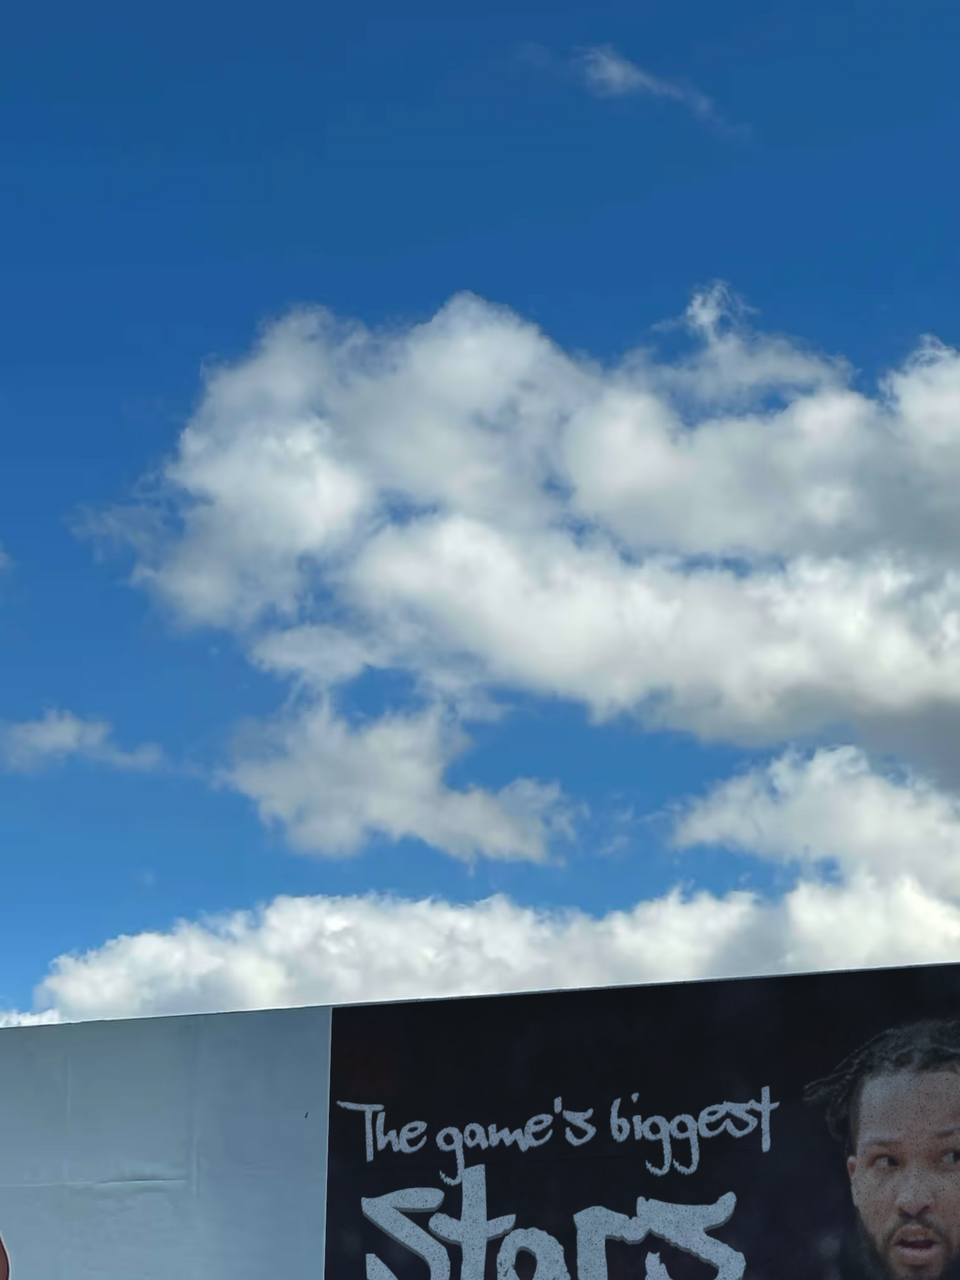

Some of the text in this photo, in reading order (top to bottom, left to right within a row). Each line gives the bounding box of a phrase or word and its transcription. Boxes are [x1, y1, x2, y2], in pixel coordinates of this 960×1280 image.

[336, 1085, 780, 1186] The game's biggest
